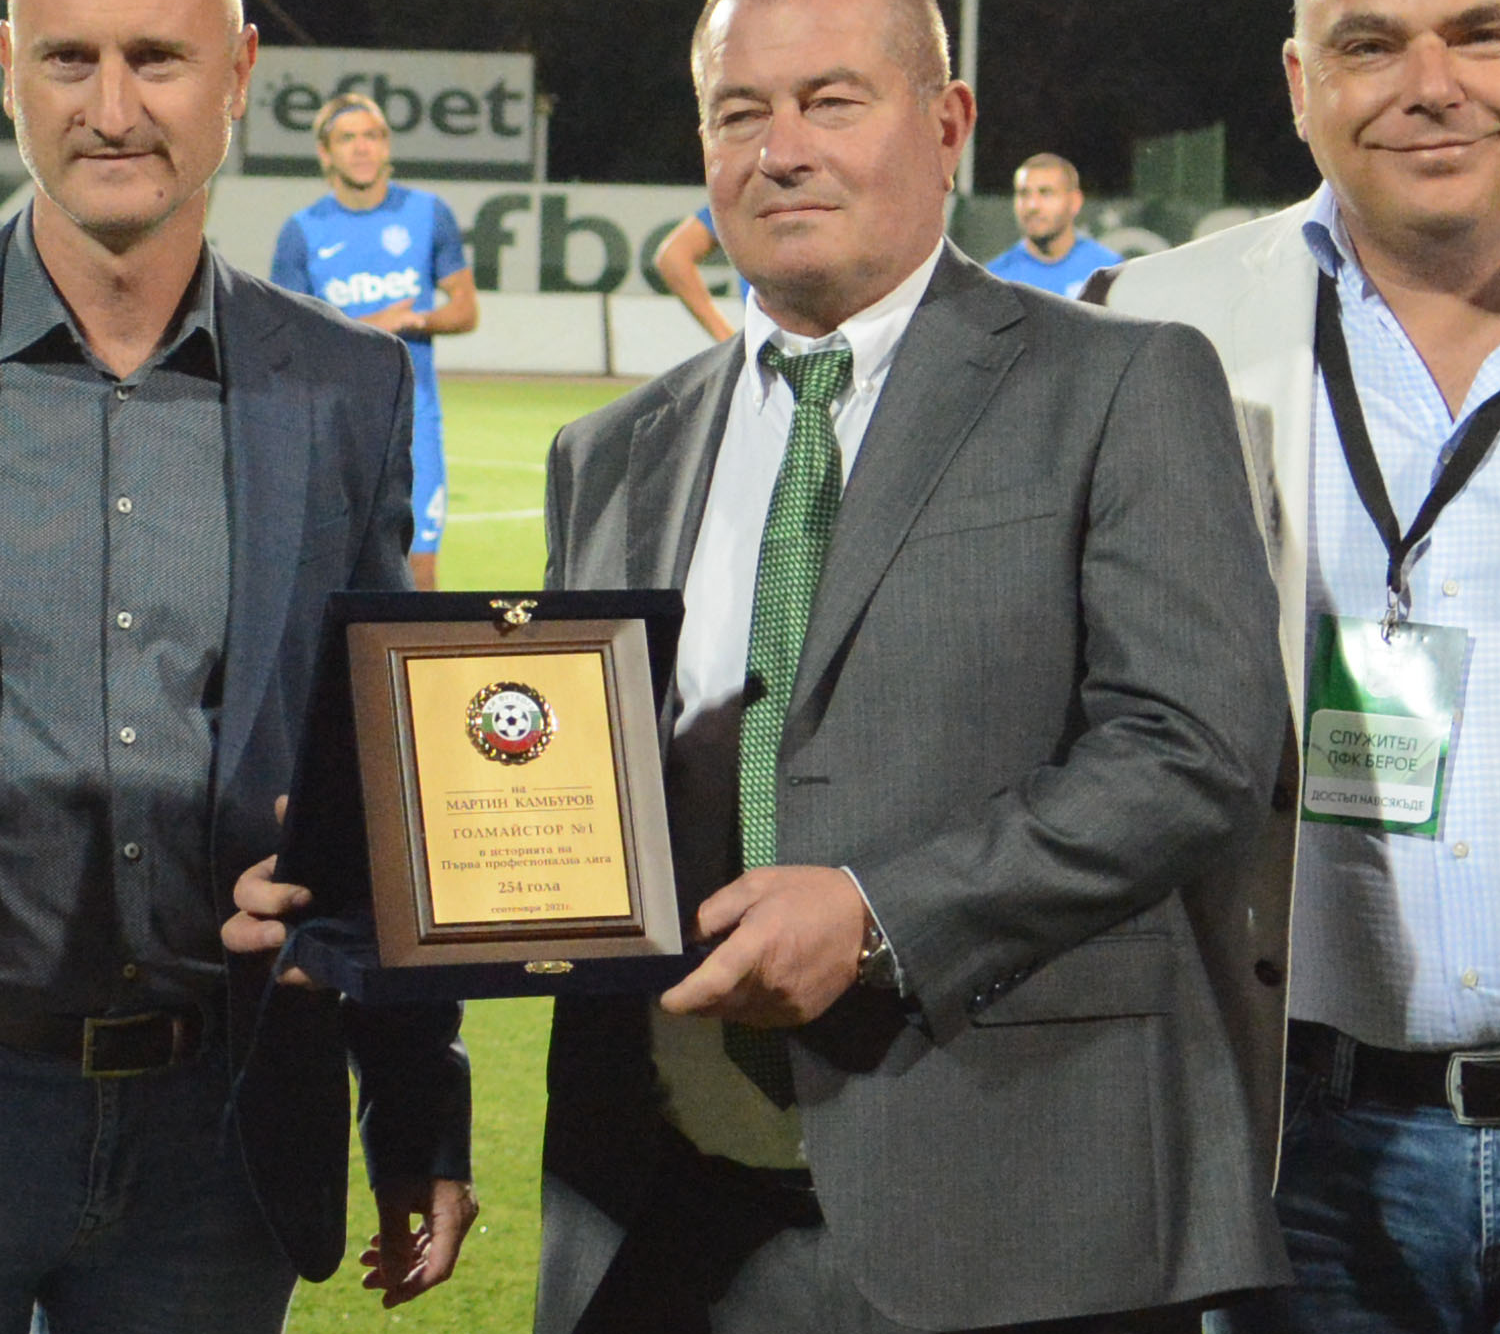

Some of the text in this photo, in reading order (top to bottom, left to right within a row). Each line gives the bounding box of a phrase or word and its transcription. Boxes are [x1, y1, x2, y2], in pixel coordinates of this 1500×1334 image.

[1329, 729, 1418, 751] СЛУЖИТЕЛ
[1328, 750, 1418, 772] ПФК БЕРОЕ
[511, 785, 527, 794] на
[1311, 789, 1358, 803] ДОСТЪП
[446, 794, 594, 811] МАРТИН КАМБУРОВ
[453, 823, 564, 839] ГОЛМАЙСТОР
[558, 845, 572, 854] на
[441, 855, 612, 871] Първа професионална лига
[498, 881, 561, 894] 254 гола
